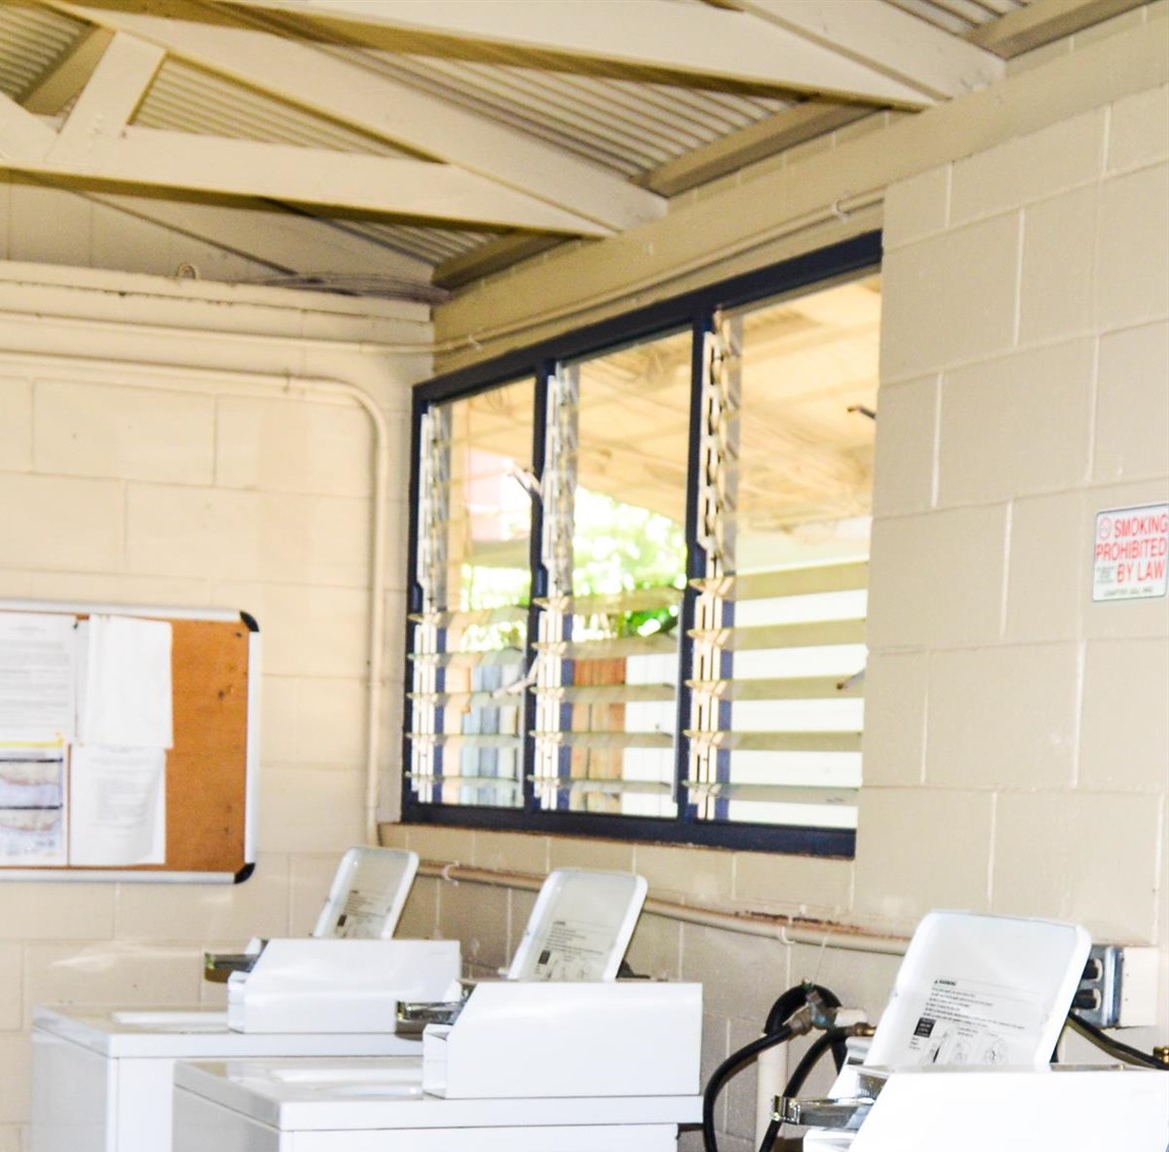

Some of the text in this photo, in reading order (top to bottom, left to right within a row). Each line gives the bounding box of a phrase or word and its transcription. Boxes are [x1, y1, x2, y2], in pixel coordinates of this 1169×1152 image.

[1114, 513, 1169, 539] SMOKING
[1095, 537, 1167, 561] PROHIBITED
[1117, 562, 1134, 583] BY
[1138, 560, 1165, 581] LAW
